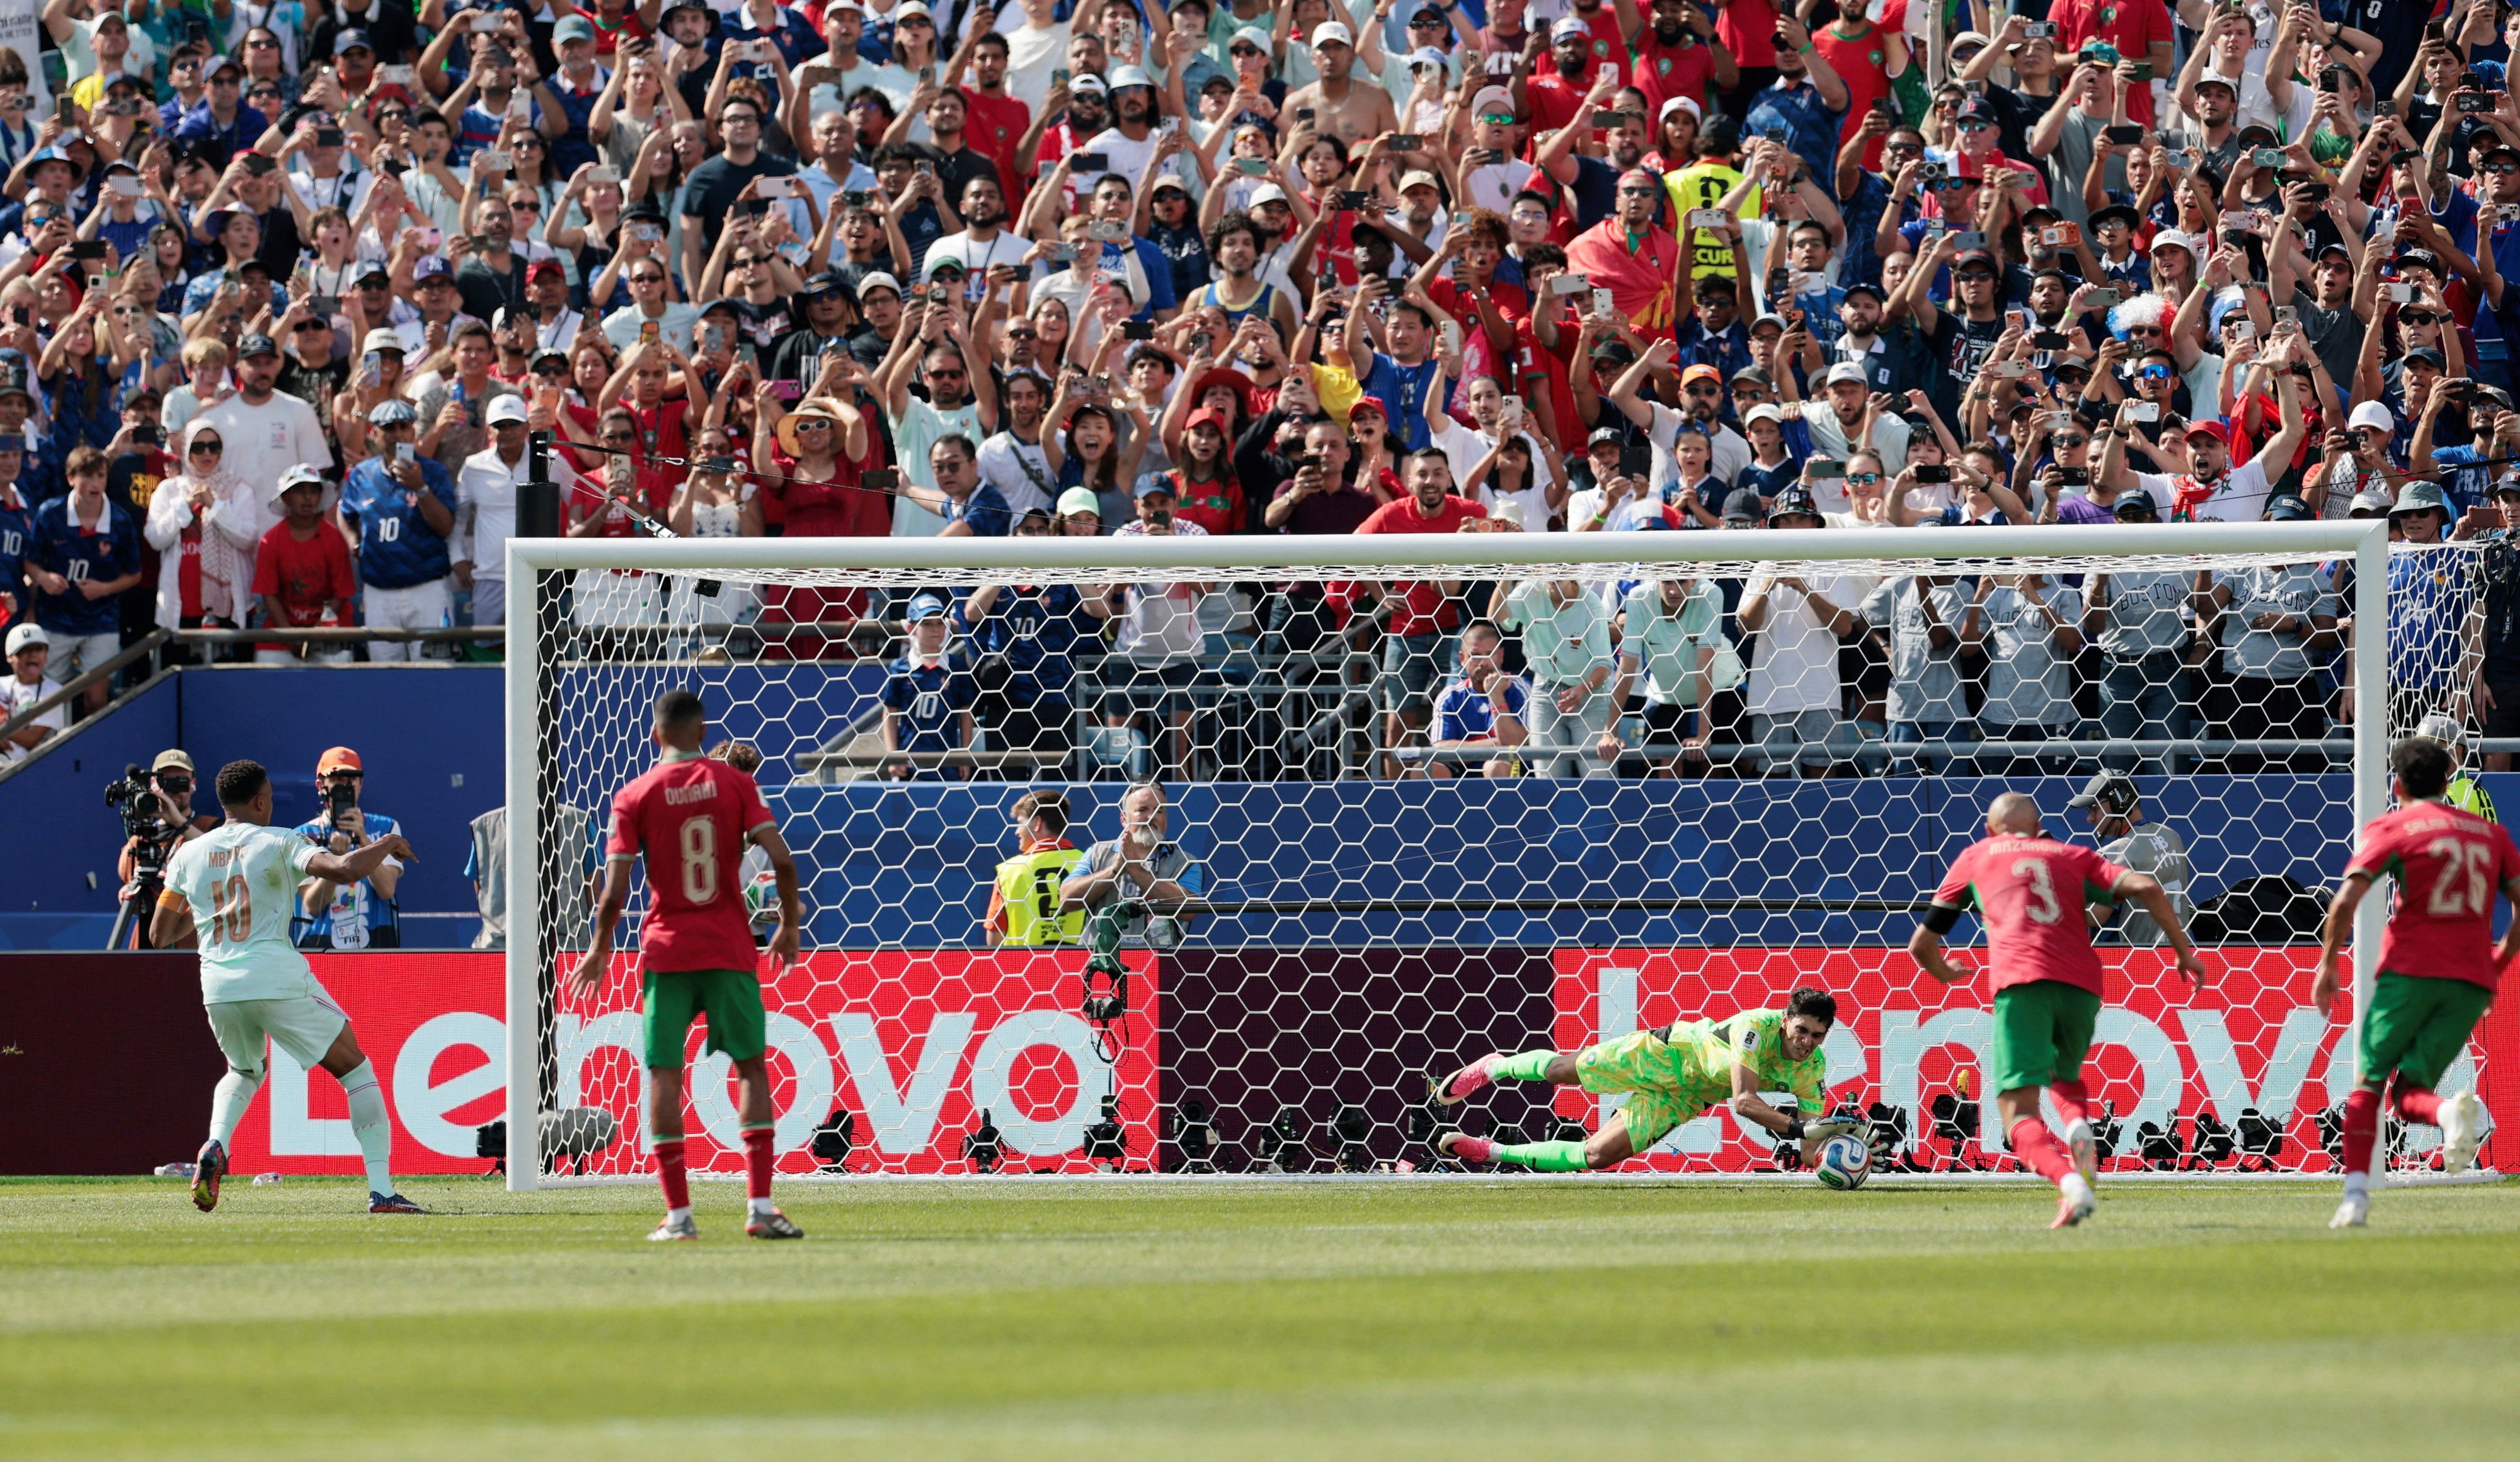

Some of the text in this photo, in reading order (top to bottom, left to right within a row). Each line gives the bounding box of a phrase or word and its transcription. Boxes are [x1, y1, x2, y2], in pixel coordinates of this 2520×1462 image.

[2282, 498, 2305, 511] BOSTON
[3, 529, 23, 557] 10
[379, 517, 400, 543] 10
[67, 558, 90, 583] 10
[2119, 582, 2182, 612] BOSTON
[2238, 589, 2305, 612] BOSTON
[2400, 599, 2426, 624] 24
[1014, 616, 1036, 641] 10
[915, 694, 939, 719] 10
[1114, 736, 1125, 745] 20
[2148, 835, 2168, 851] HB
[680, 814, 719, 905] 8
[2427, 838, 2492, 917] 26
[2011, 857, 2064, 925] 3
[211, 874, 251, 945] 10
[1598, 968, 2478, 1154] Lenovo
[270, 1010, 1115, 1158] Lenovo
